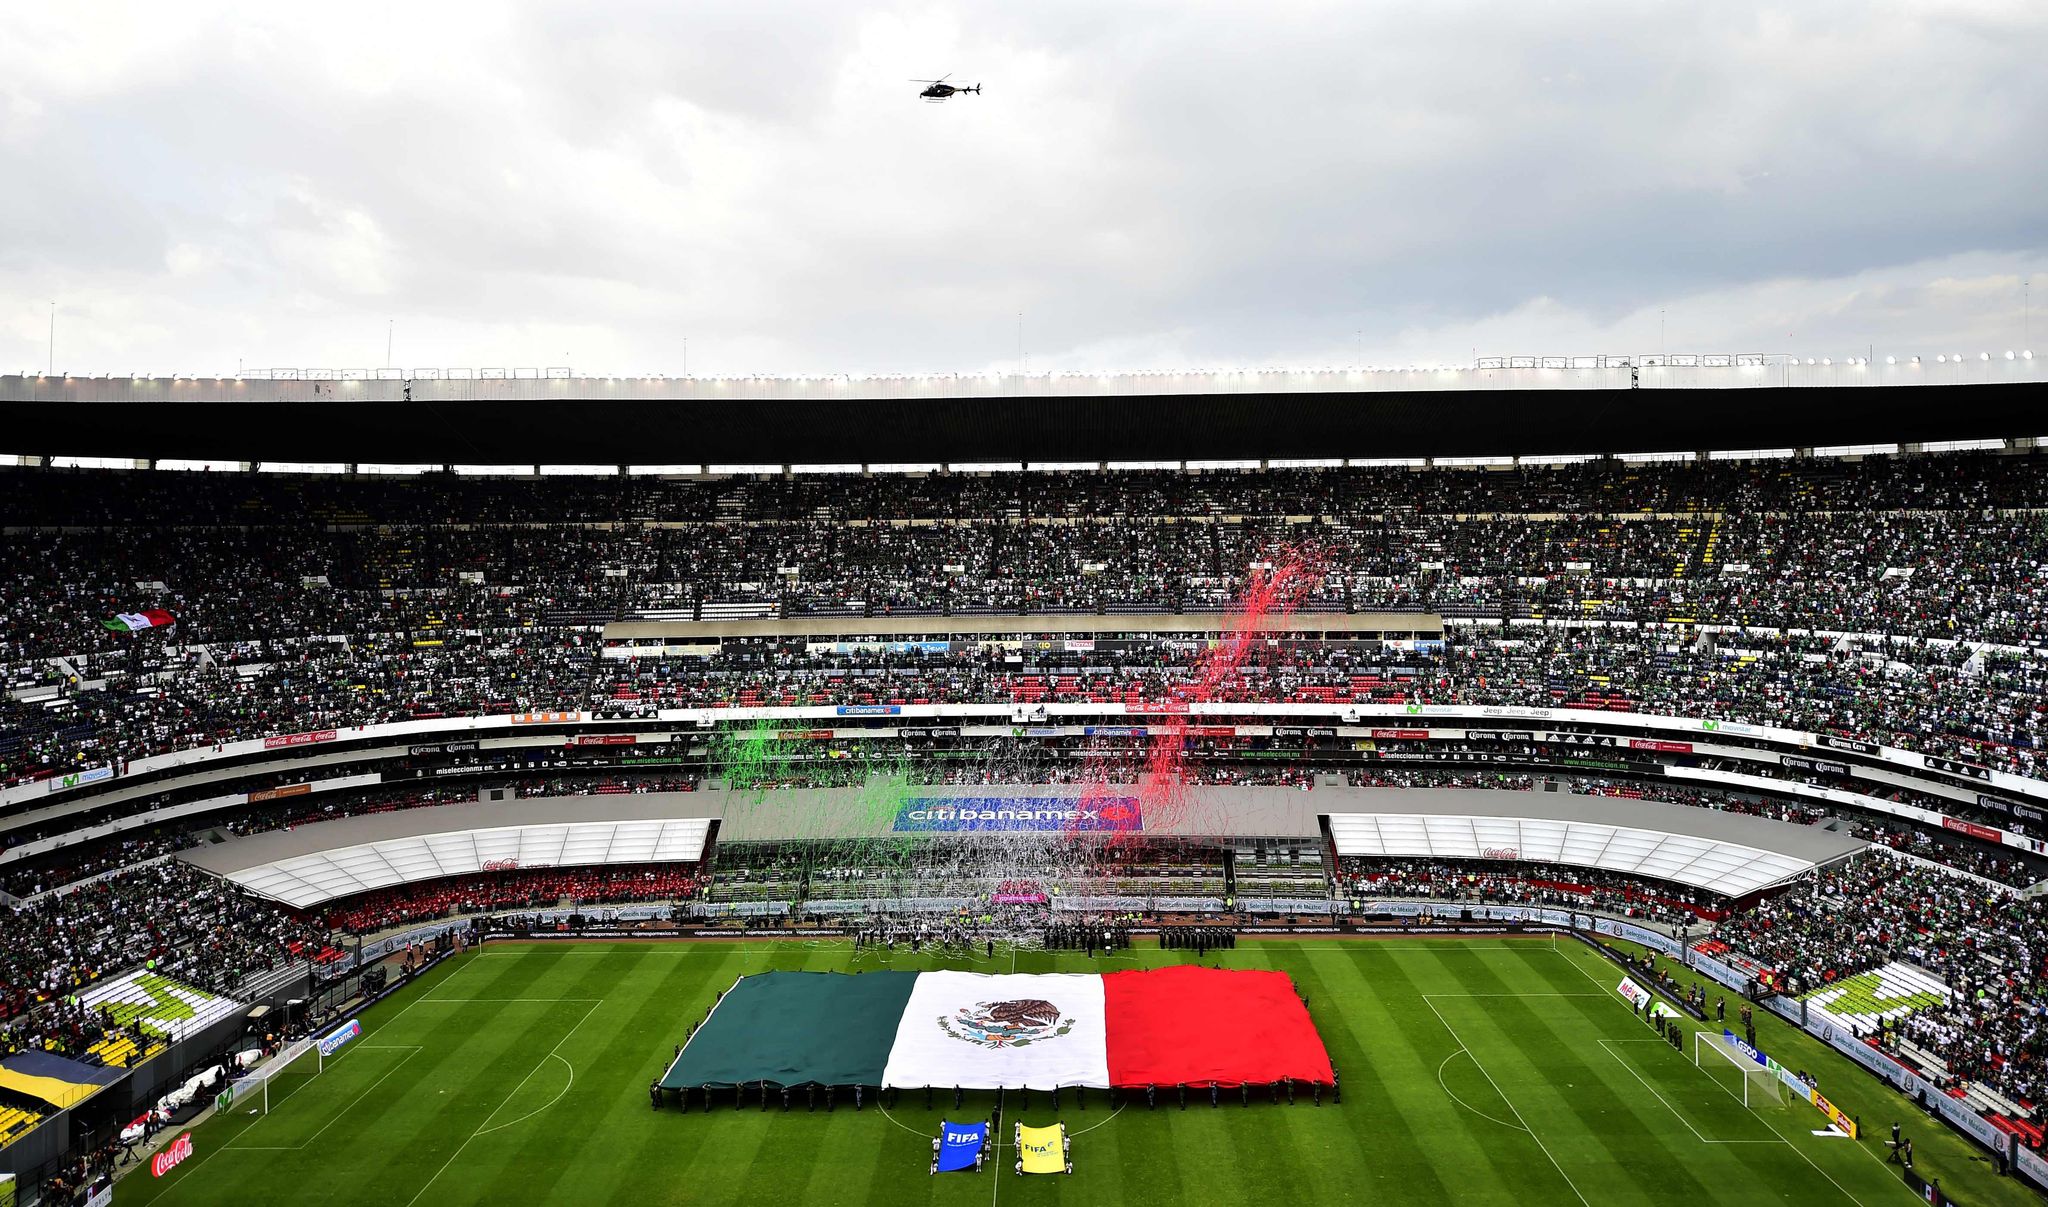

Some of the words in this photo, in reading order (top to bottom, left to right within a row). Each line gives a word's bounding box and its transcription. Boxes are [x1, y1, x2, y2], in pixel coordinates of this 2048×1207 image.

[1506, 707, 1526, 715] Jeep
[1530, 708, 1550, 716] Jeep
[1275, 728, 1302, 736] Corona
[1307, 728, 1333, 736] Corona
[1468, 731, 1496, 740] Corona
[1501, 732, 1530, 741] Corona
[446, 743, 475, 753] Corona
[1828, 738, 1851, 748] Corona
[1782, 756, 1810, 769] Corona
[1815, 762, 1844, 774] Corona
[908, 806, 1099, 821] citibanamex
[1979, 796, 2008, 812] Corona
[2013, 805, 2043, 821] Corona
[947, 1132, 979, 1143] FIFA
[1025, 1144, 1047, 1153] FIFA
[157, 1134, 193, 1177] Coca-Cola
